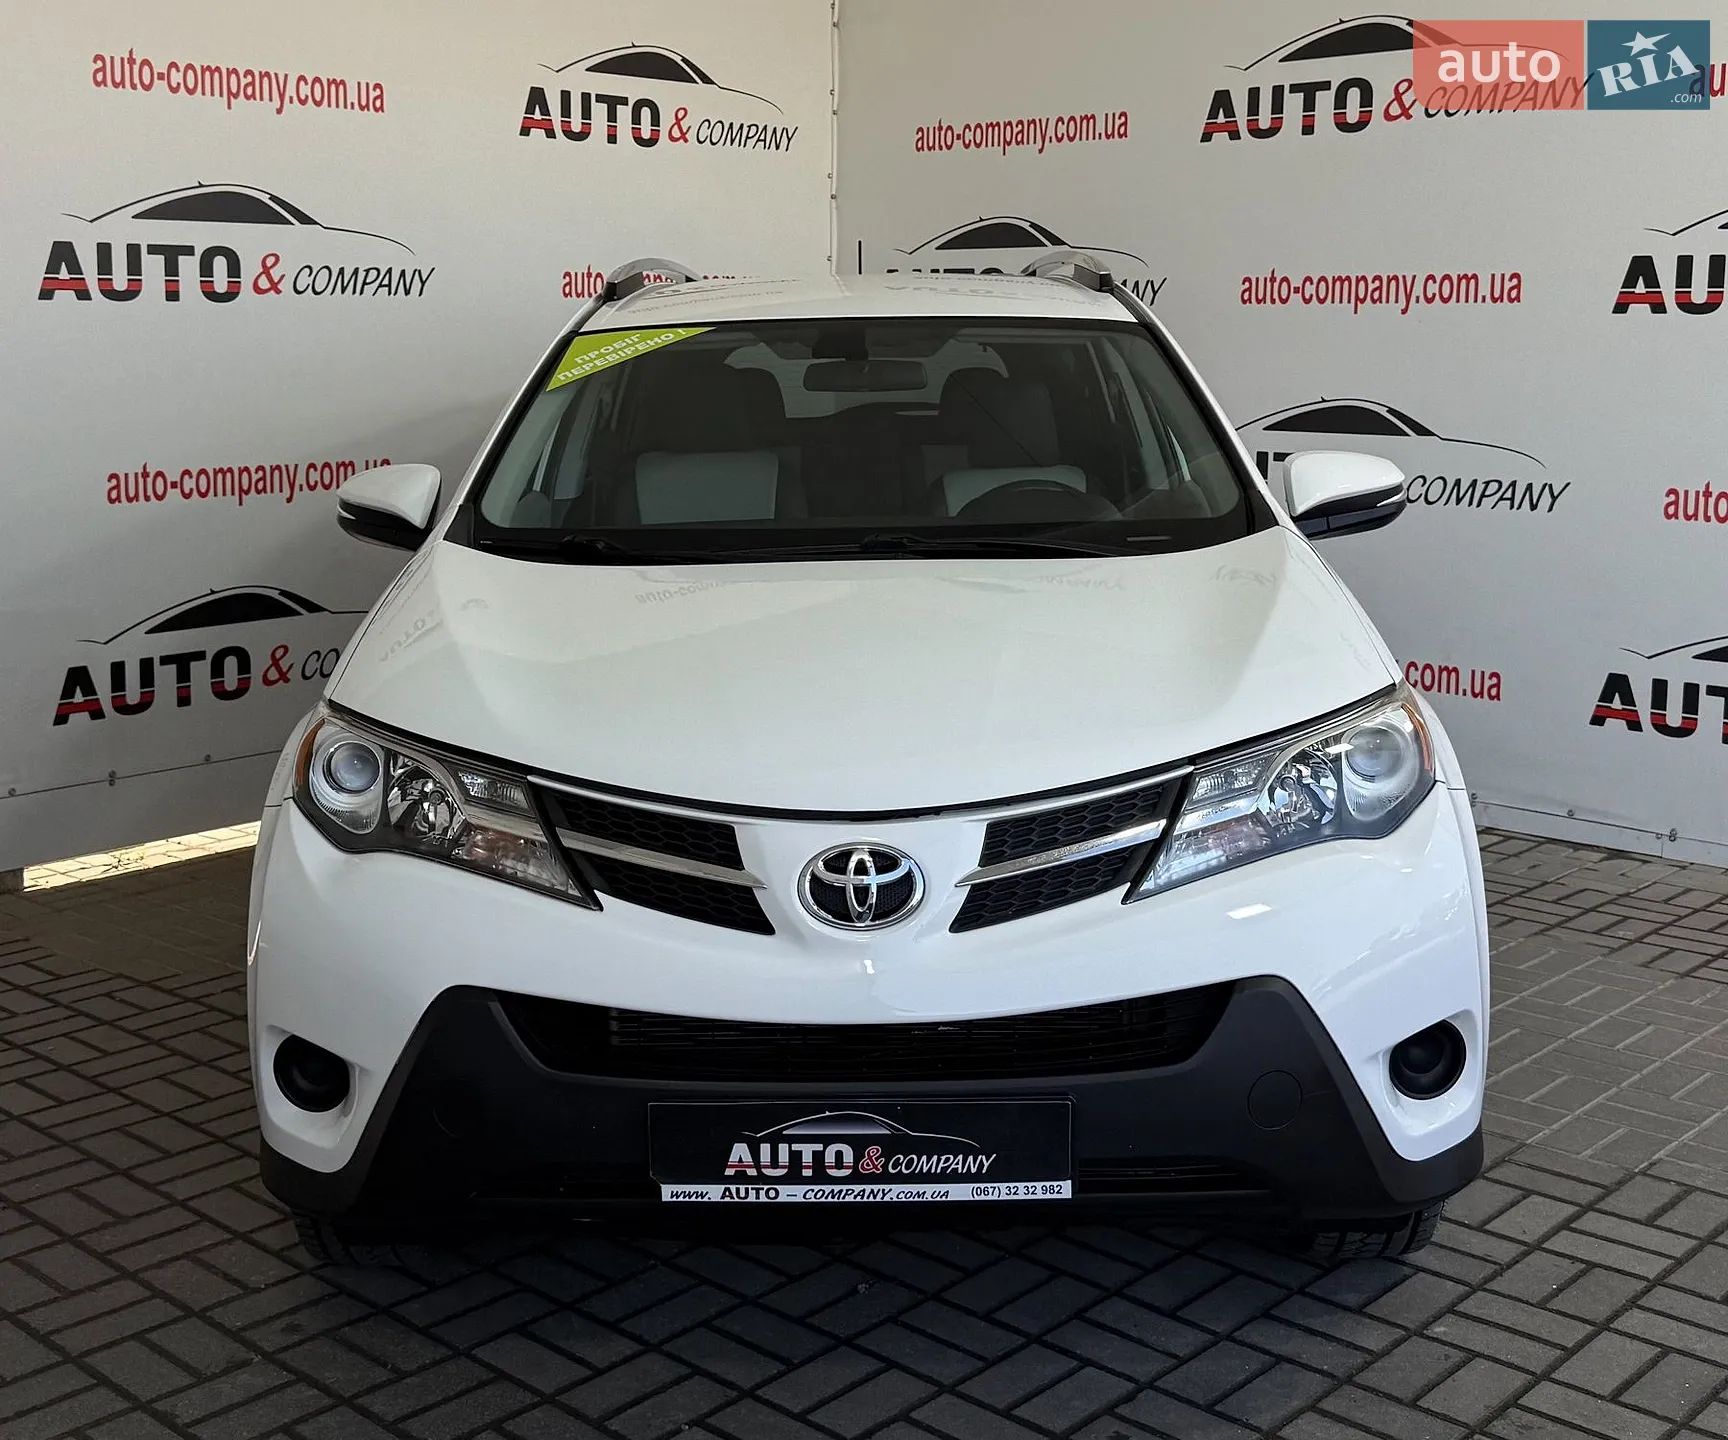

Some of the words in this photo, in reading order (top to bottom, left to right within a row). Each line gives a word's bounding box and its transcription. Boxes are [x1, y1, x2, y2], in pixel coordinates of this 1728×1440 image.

[92, 48, 385, 115] auto-company.com.ua
[519, 85, 661, 148] AUTO
[668, 107, 691, 144] &
[696, 118, 798, 152] COMPANY
[1200, 78, 1374, 142] AUTO
[1383, 78, 1417, 122] &
[1424, 72, 1595, 119] COMPANY
[915, 111, 1128, 156] auto-company.com.ua
[37, 240, 242, 304] AUTO
[252, 252, 286, 296] &
[292, 264, 436, 298] COMPANY
[1240, 267, 1523, 315] auto-company.com.ua
[574, 334, 642, 364] ПРОБІГ
[106, 457, 392, 507] auto-company.com
[1406, 474, 1571, 513] COMPANY
[52, 645, 252, 726] AUTO
[261, 644, 295, 687] &
[724, 1142, 854, 1177] AUTO
[858, 1145, 885, 1174] &
[887, 1153, 996, 1175] COMPANY
[719, 1186, 780, 1201] AUTO
[970, 1186, 1001, 1199] (067)
[1005, 1185, 1019, 1197] 32
[1023, 1185, 1038, 1197] 32
[1040, 1184, 1064, 1196] 982
